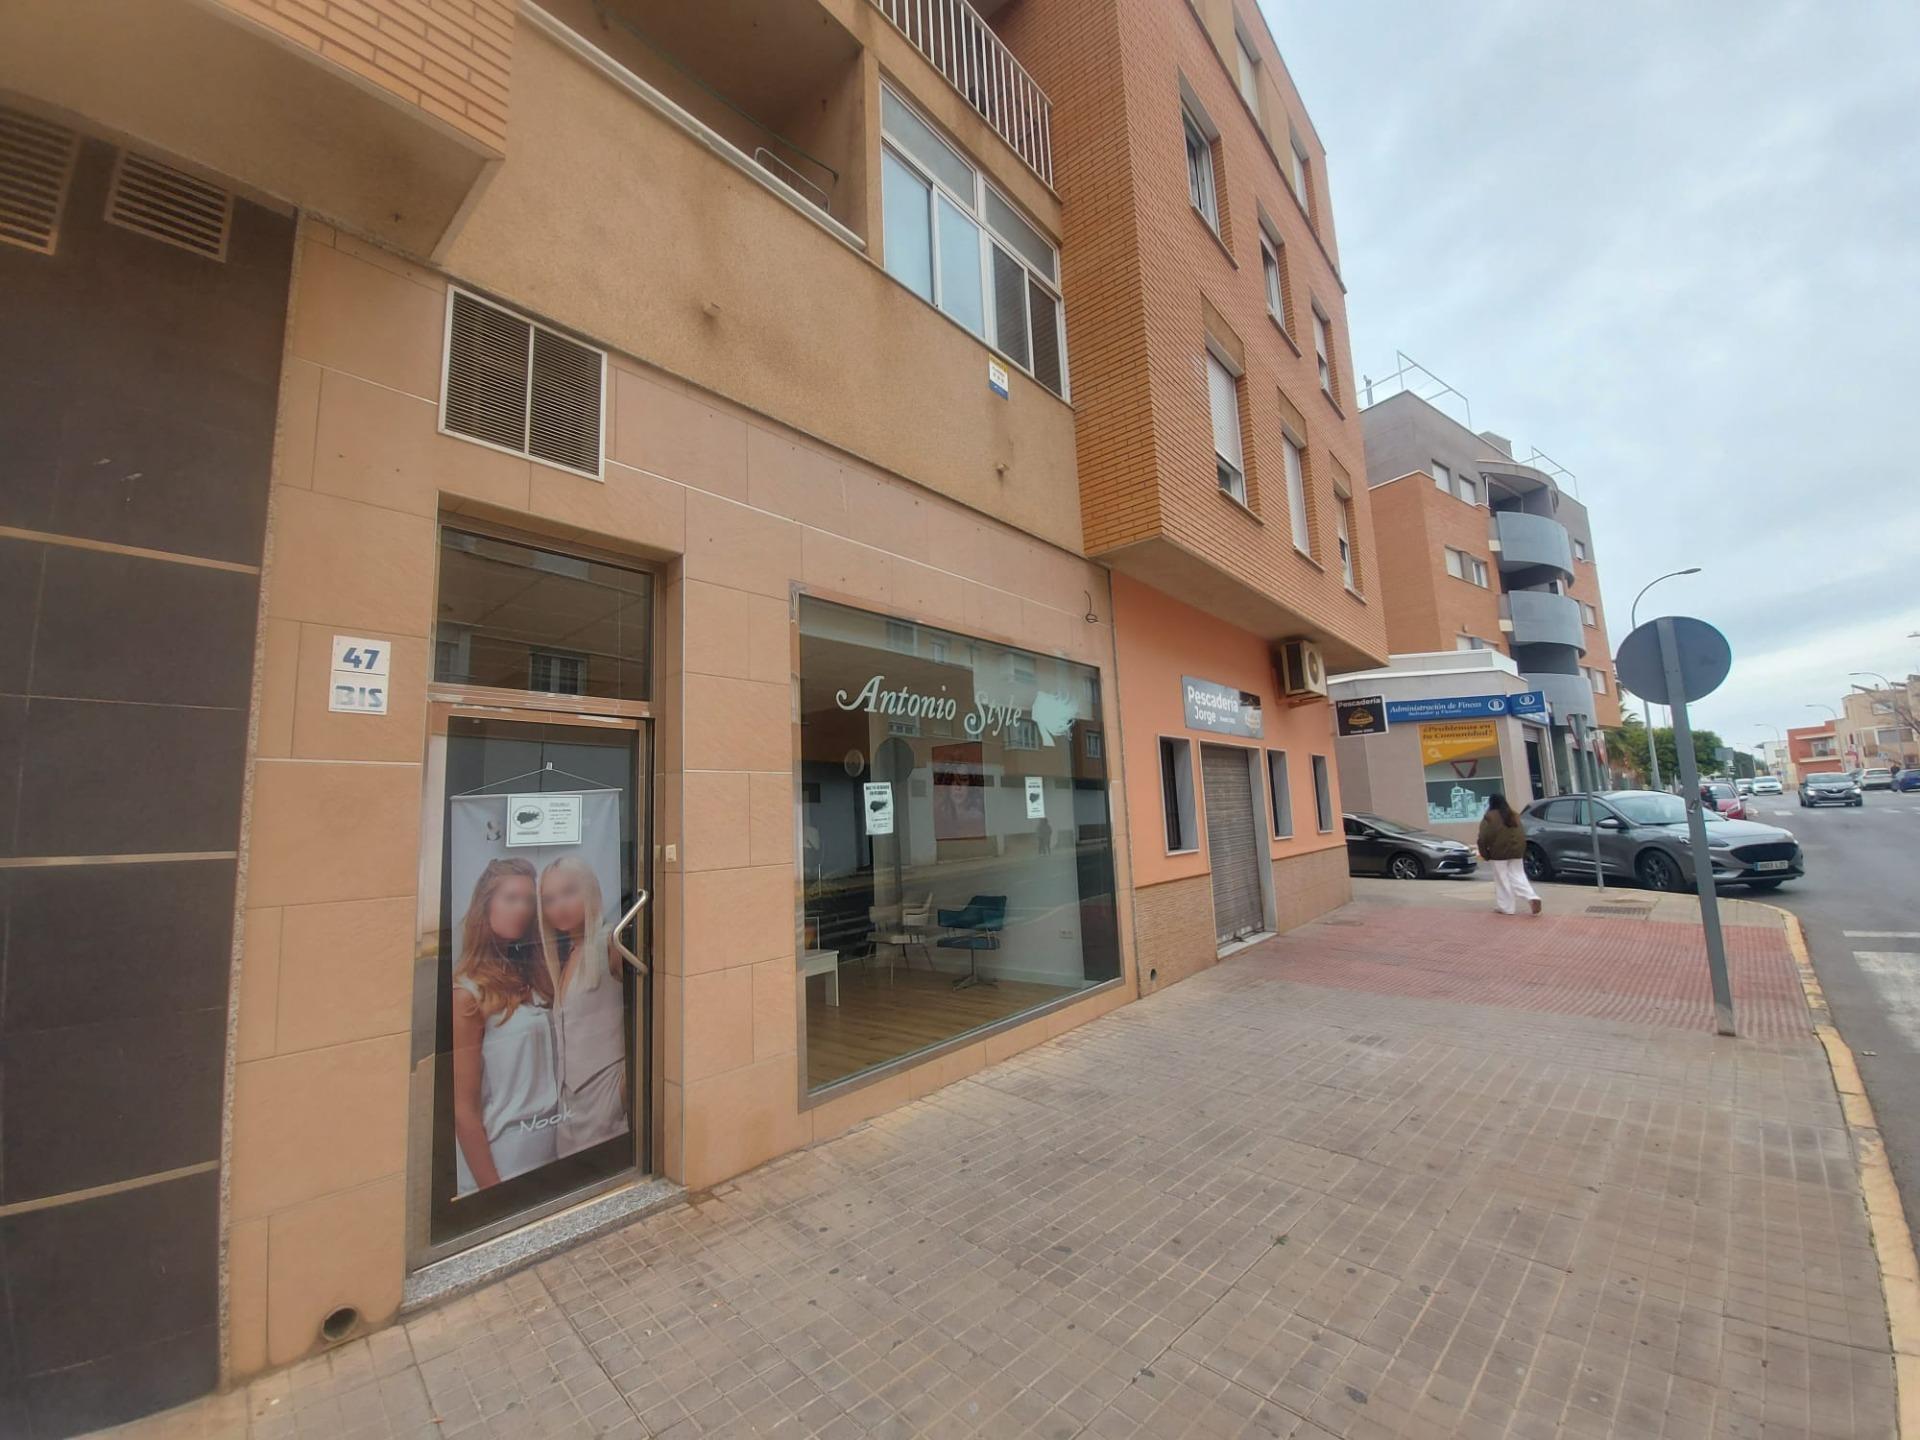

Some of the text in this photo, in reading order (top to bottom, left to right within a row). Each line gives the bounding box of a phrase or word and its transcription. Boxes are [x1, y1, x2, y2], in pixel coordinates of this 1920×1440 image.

[343, 647, 380, 669] 47
[335, 685, 383, 707] BIS
[836, 675, 1022, 736] Antonio Style
[1447, 701, 1456, 709] de
[1457, 700, 1482, 709] Fincas
[1194, 705, 1217, 725] Jorge
[520, 1103, 576, 1133] Nook
